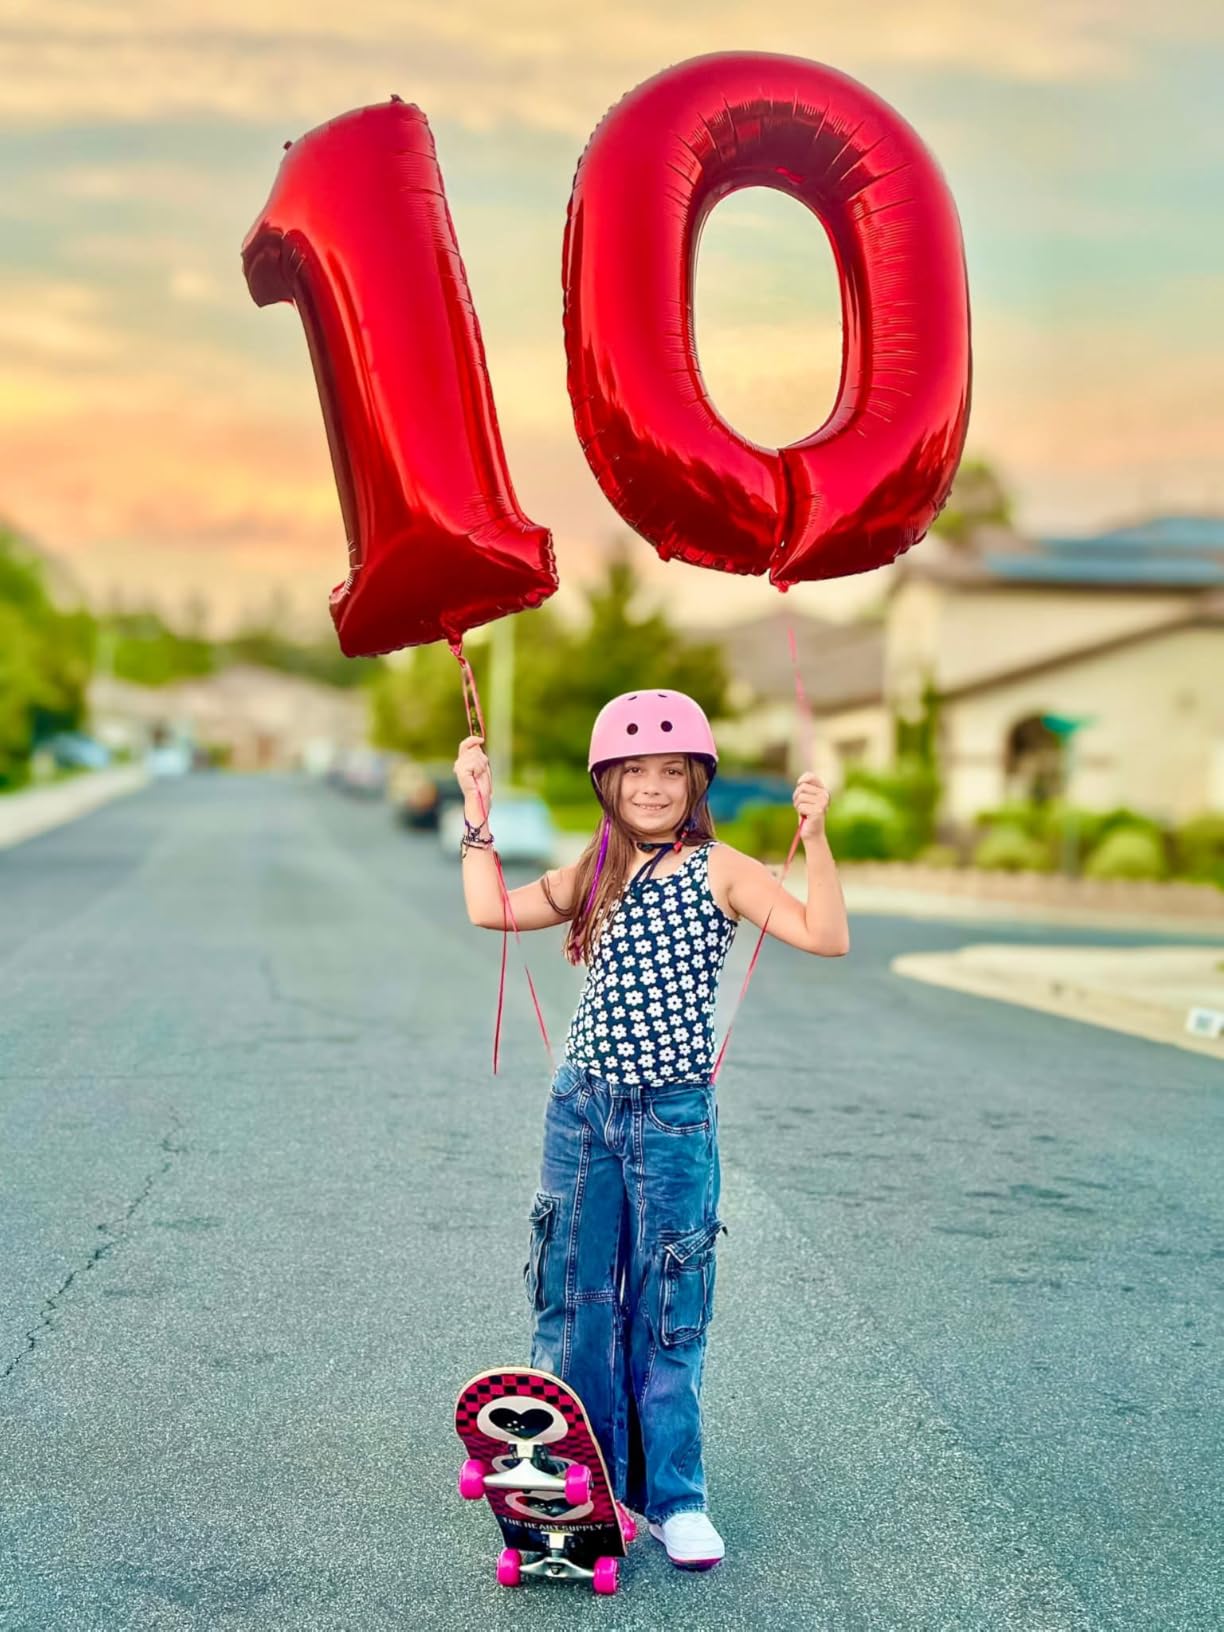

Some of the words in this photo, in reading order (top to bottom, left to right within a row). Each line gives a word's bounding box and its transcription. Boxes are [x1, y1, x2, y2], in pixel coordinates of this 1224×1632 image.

[241, 50, 972, 658] 10
[502, 1517, 522, 1527] THE
[524, 1522, 559, 1532] HEART
[561, 1523, 603, 1532] SUPPLY
